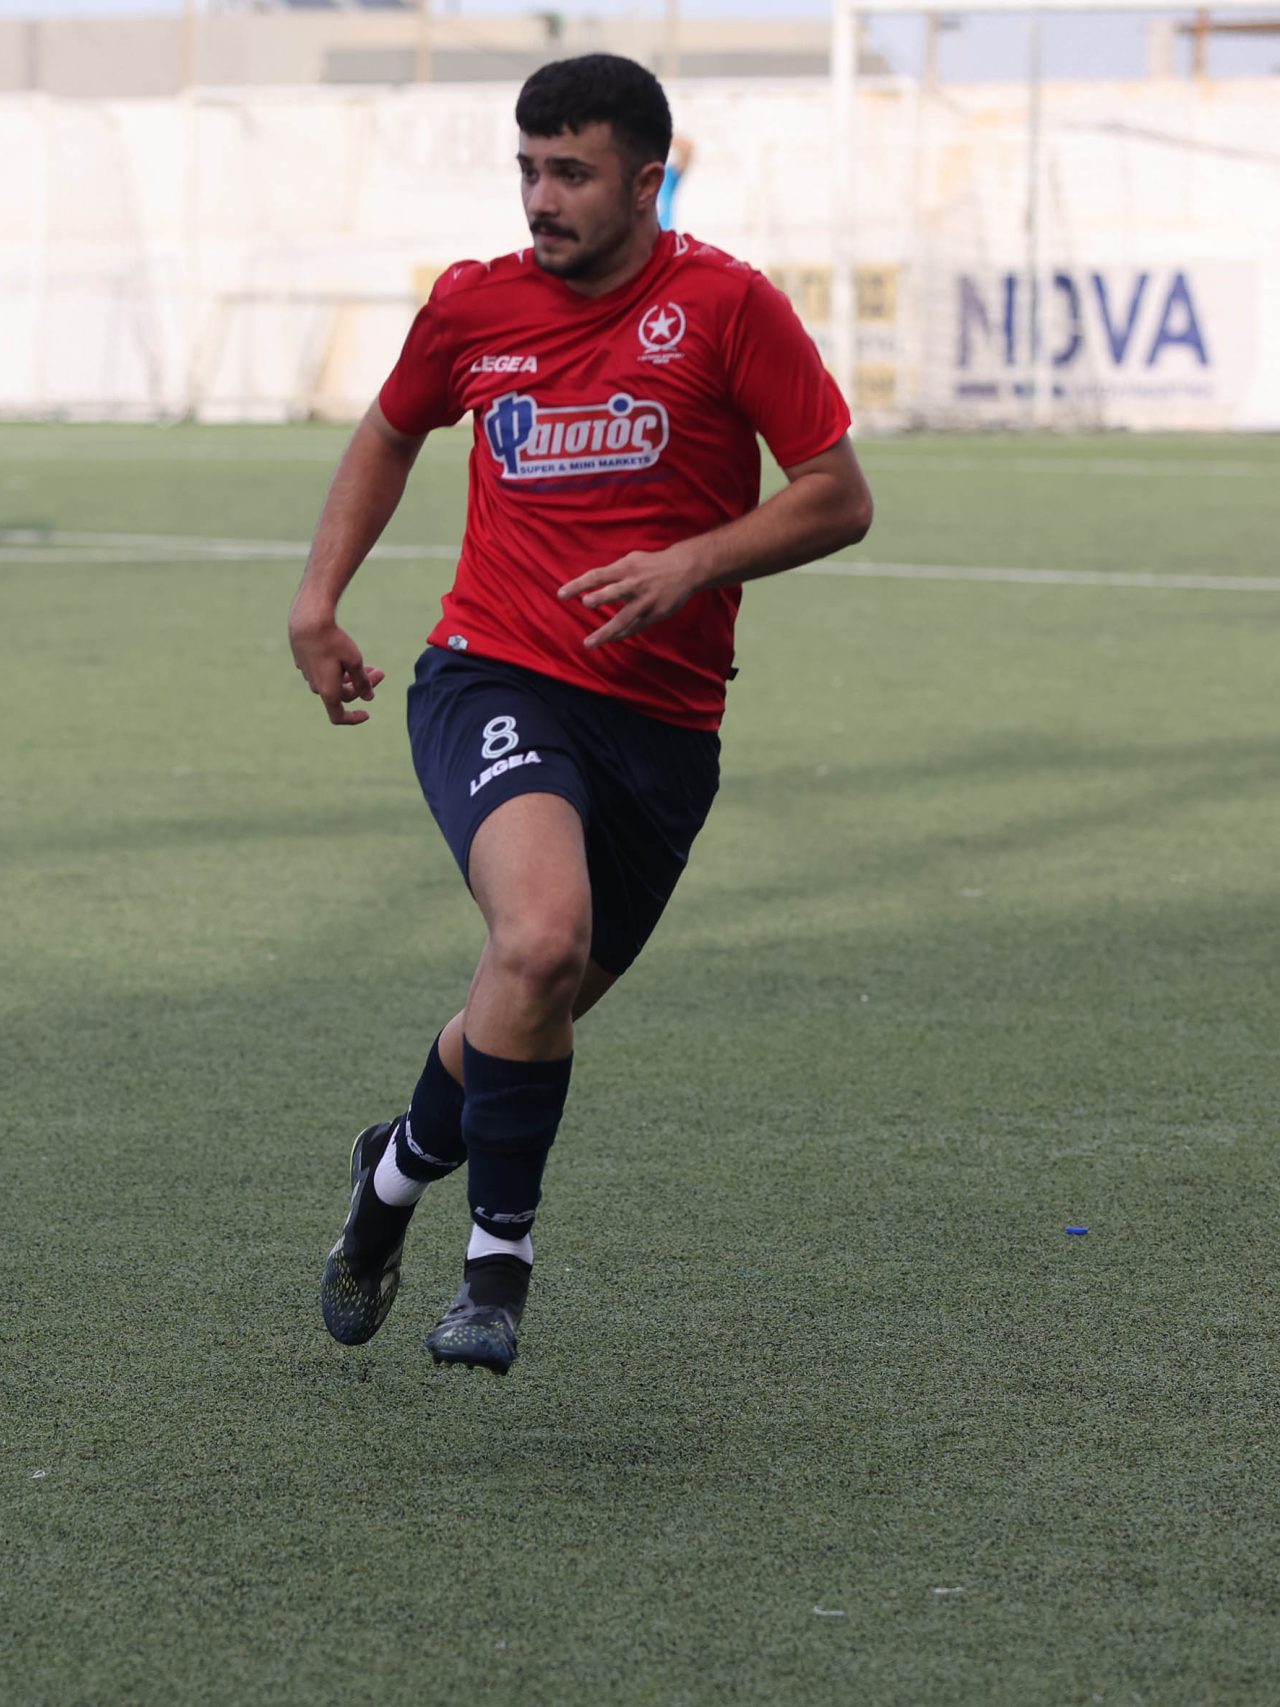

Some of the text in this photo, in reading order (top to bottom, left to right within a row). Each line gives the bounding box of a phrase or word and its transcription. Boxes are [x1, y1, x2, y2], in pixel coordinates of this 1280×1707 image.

[471, 355, 537, 373] LEGEA
[520, 455, 651, 475] SUPER & MINI MARKETS
[481, 715, 519, 759] 8
[469, 750, 542, 797] LEGEA
